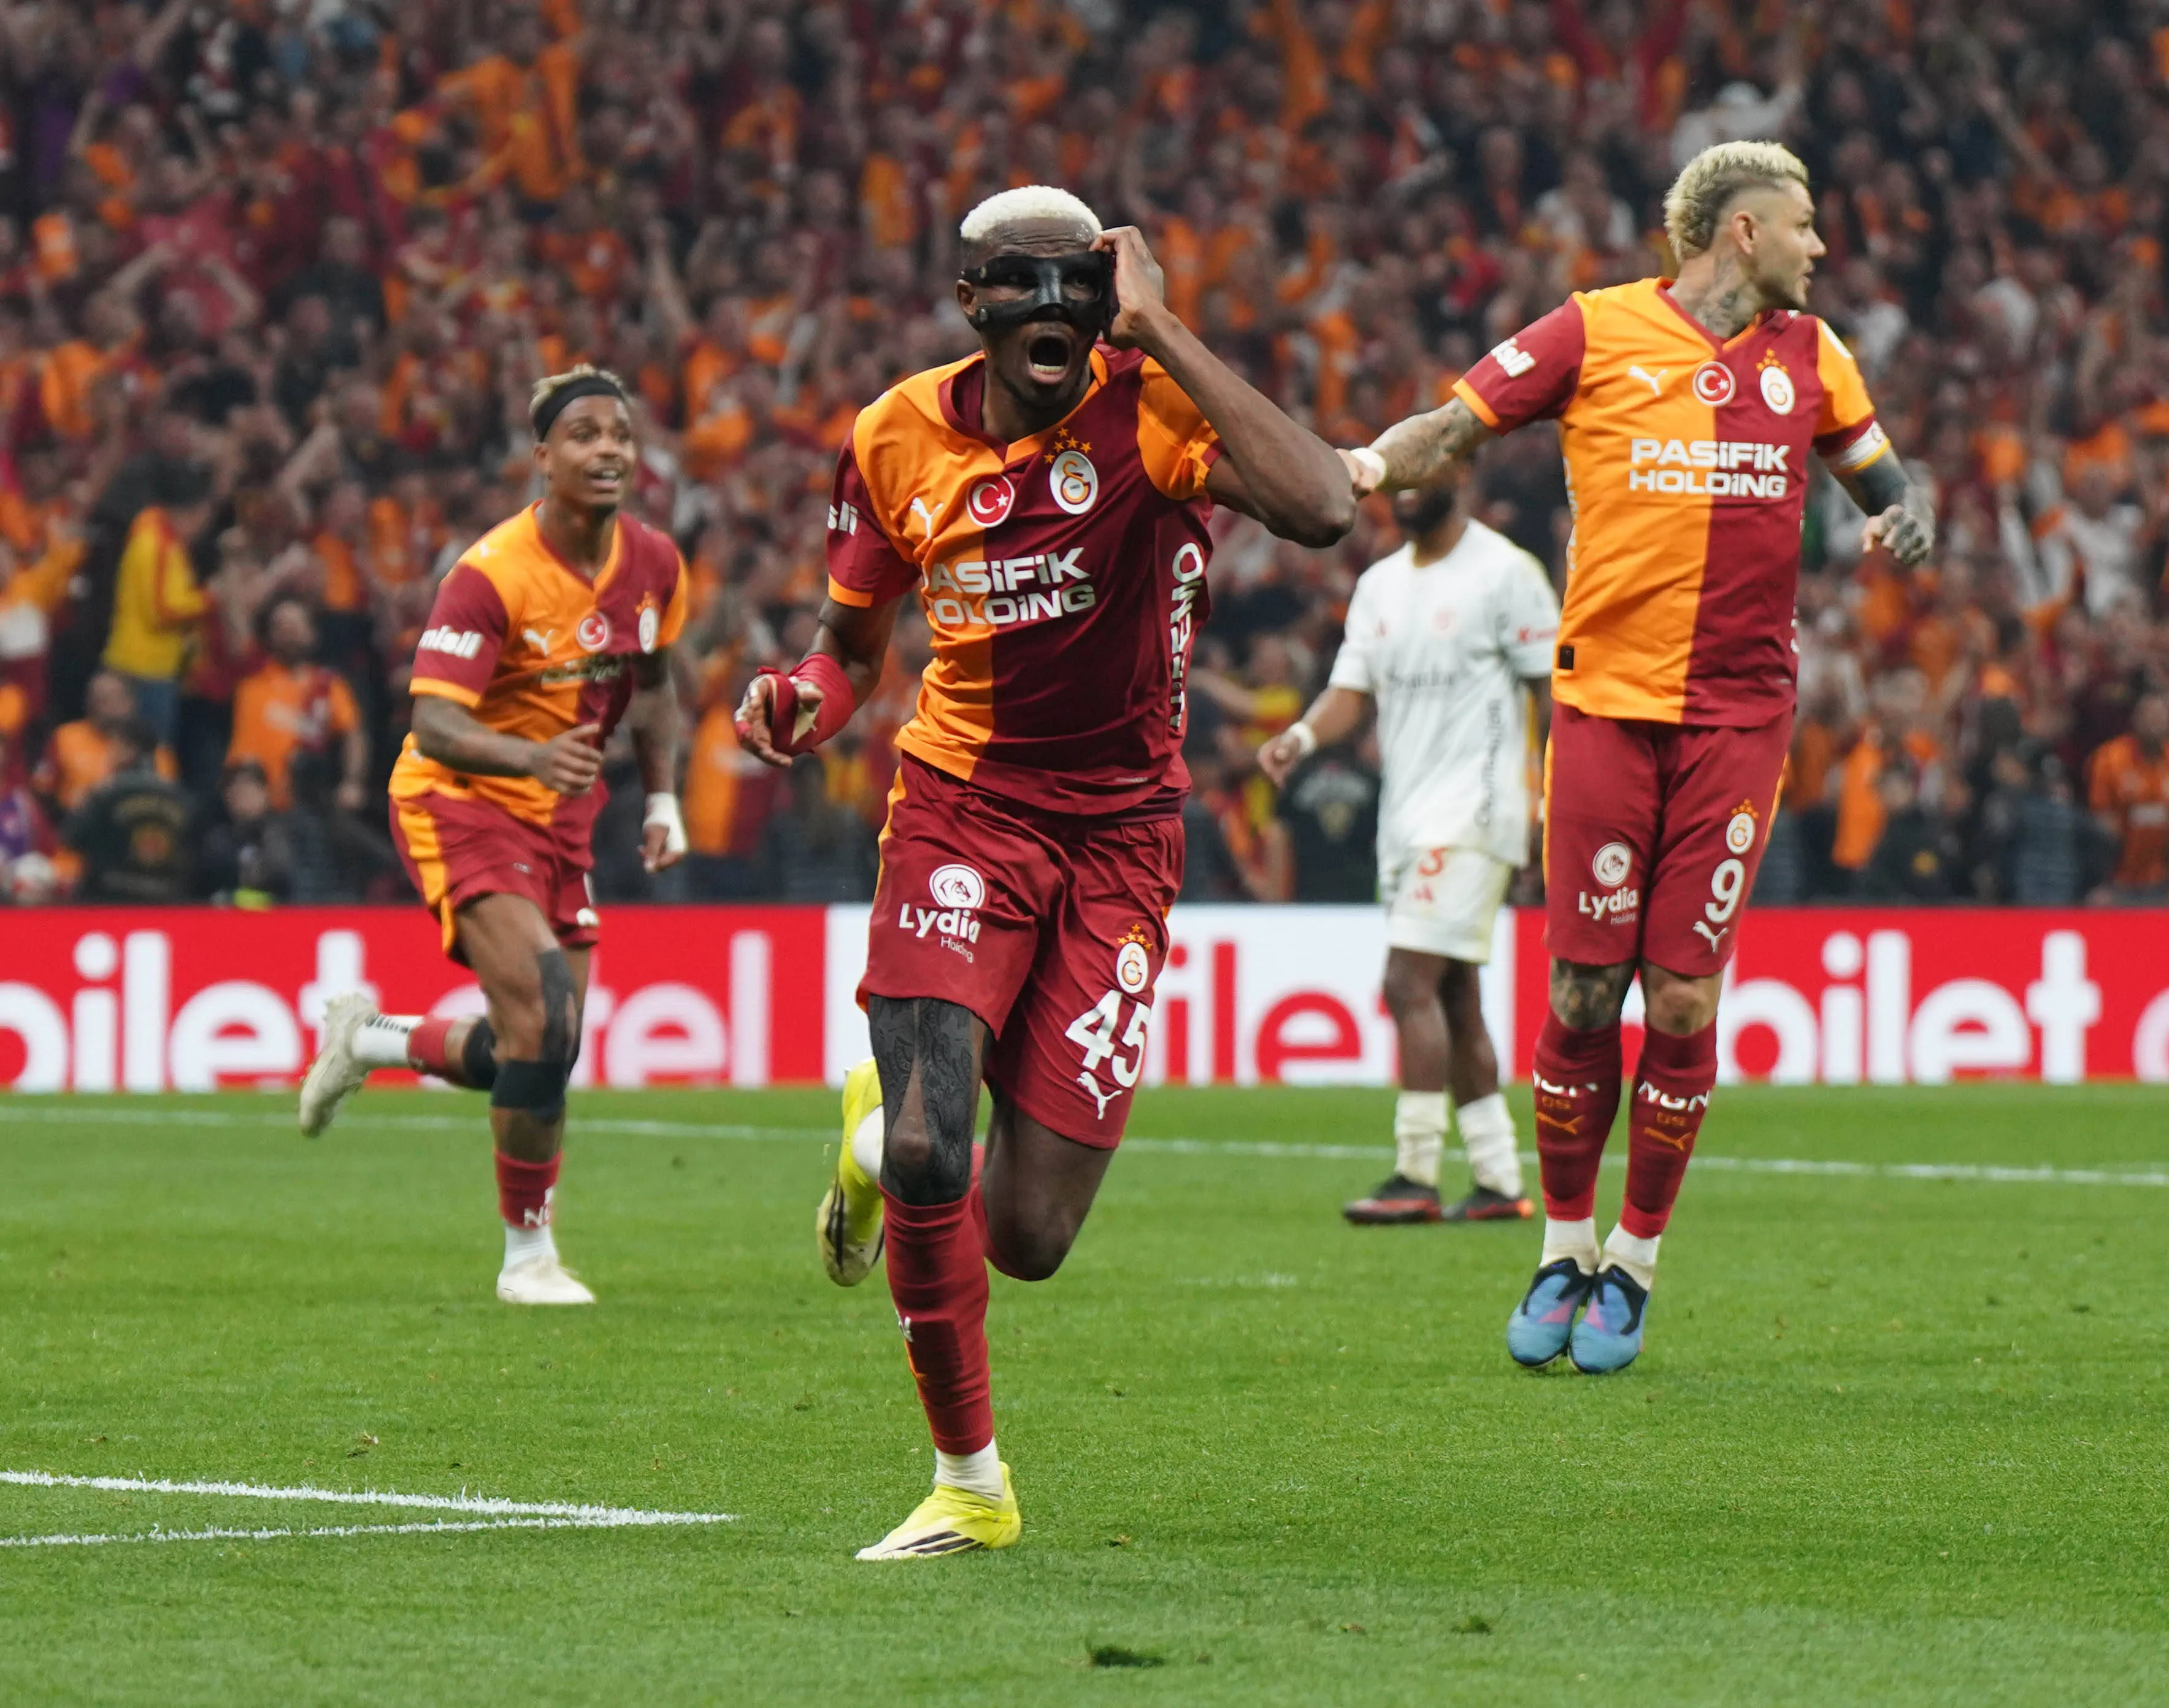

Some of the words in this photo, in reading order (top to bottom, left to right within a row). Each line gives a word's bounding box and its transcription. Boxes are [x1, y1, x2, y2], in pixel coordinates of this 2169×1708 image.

[1578, 887, 1639, 921] Lydia
[1705, 858, 1745, 924] 9
[1065, 989, 1151, 1088] 45
